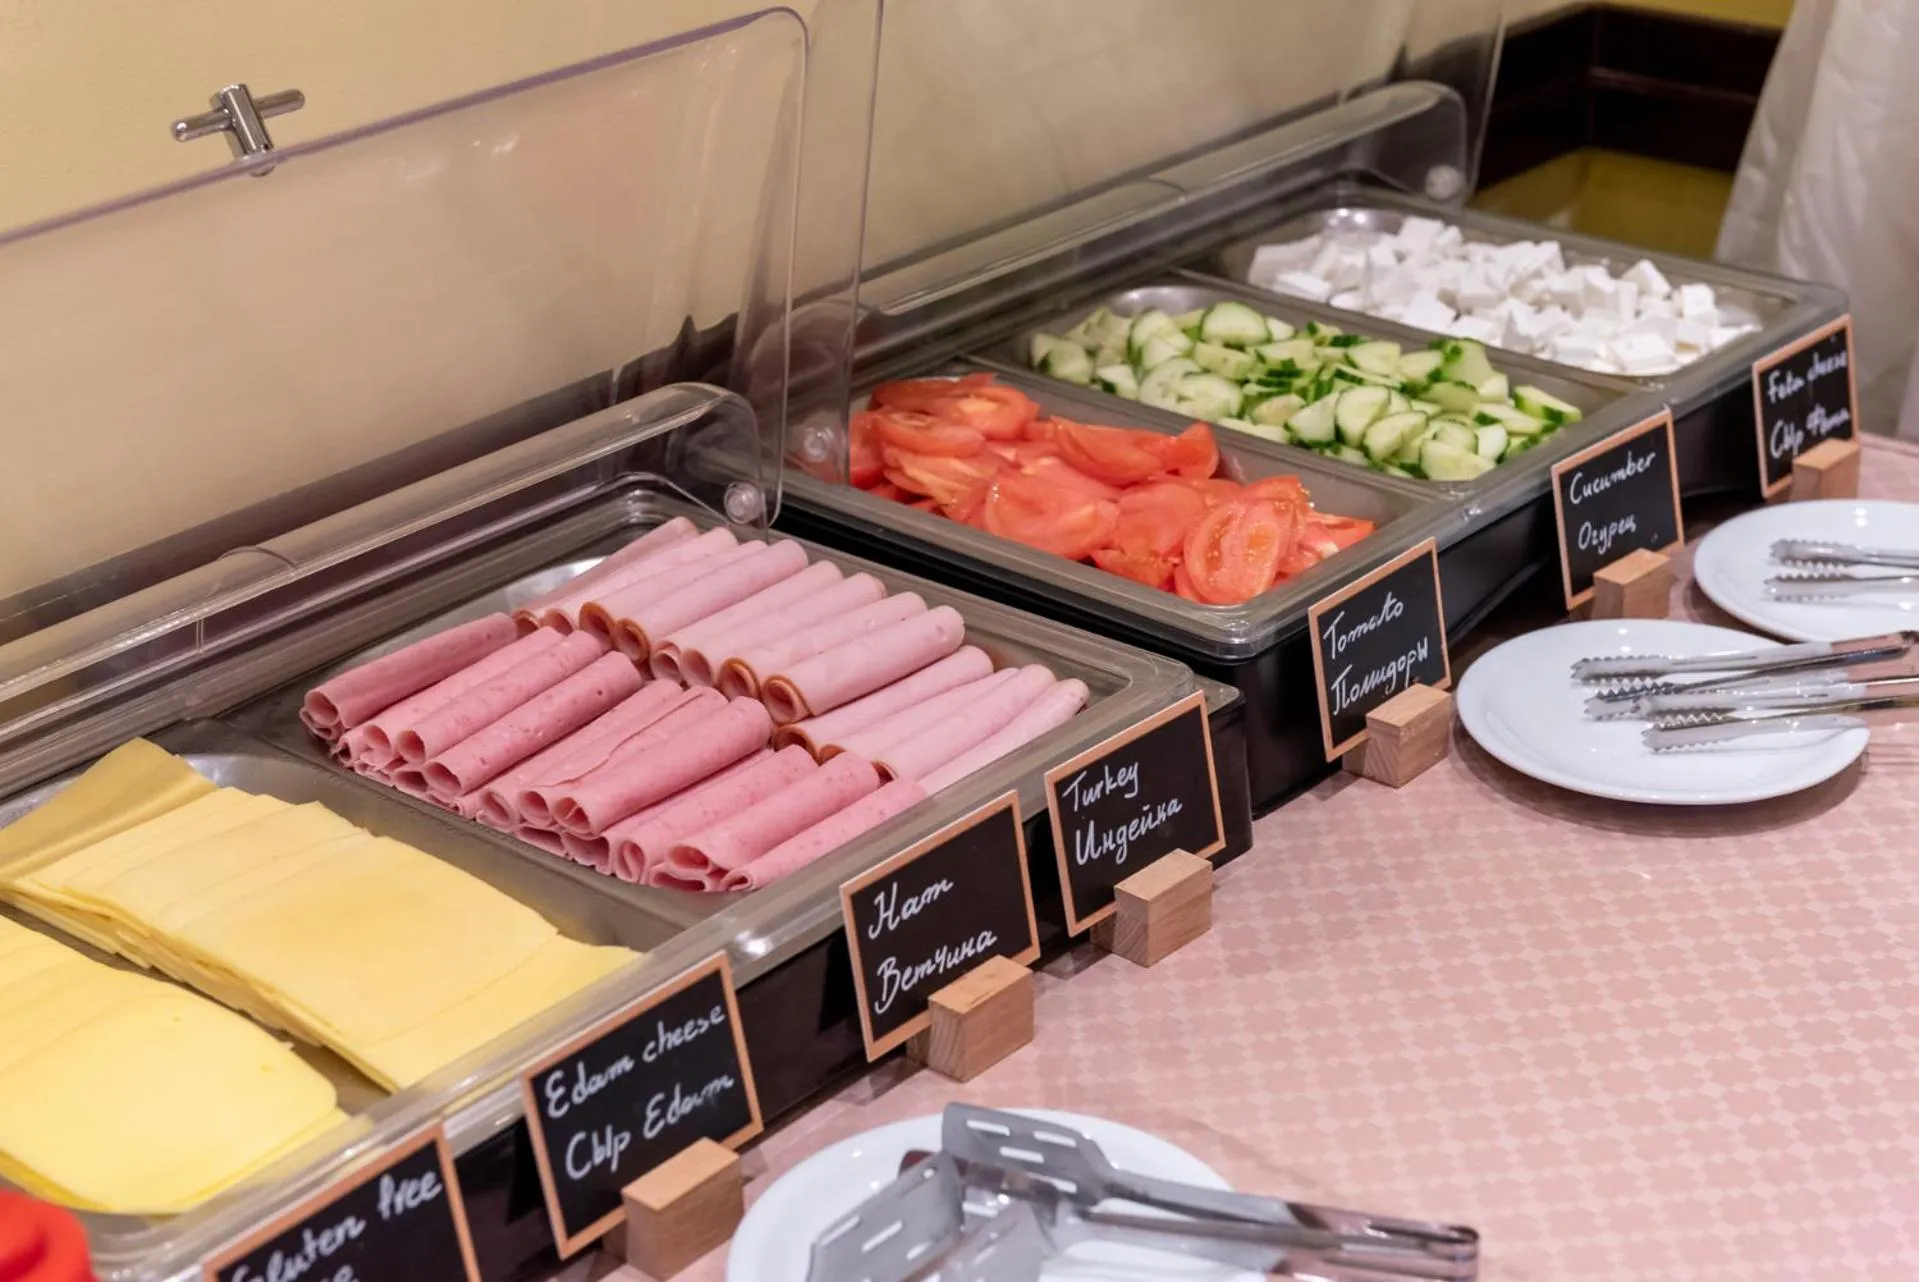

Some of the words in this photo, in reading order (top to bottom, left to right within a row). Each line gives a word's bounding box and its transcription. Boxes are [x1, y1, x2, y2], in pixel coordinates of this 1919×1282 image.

[1570, 450, 1656, 504] Cucumber
[1578, 514, 1637, 555] Огурец
[1323, 591, 1404, 660] Tomato
[1331, 636, 1429, 715] Помидоры
[1062, 762, 1139, 812] Turkey
[1075, 798, 1183, 866] Индейка
[868, 877, 954, 940] Ham
[874, 929, 998, 1015] Ветчина
[545, 1061, 634, 1119] Edam
[642, 1005, 726, 1063] cheese
[565, 1124, 631, 1180] Сыр
[377, 1170, 443, 1220] free
